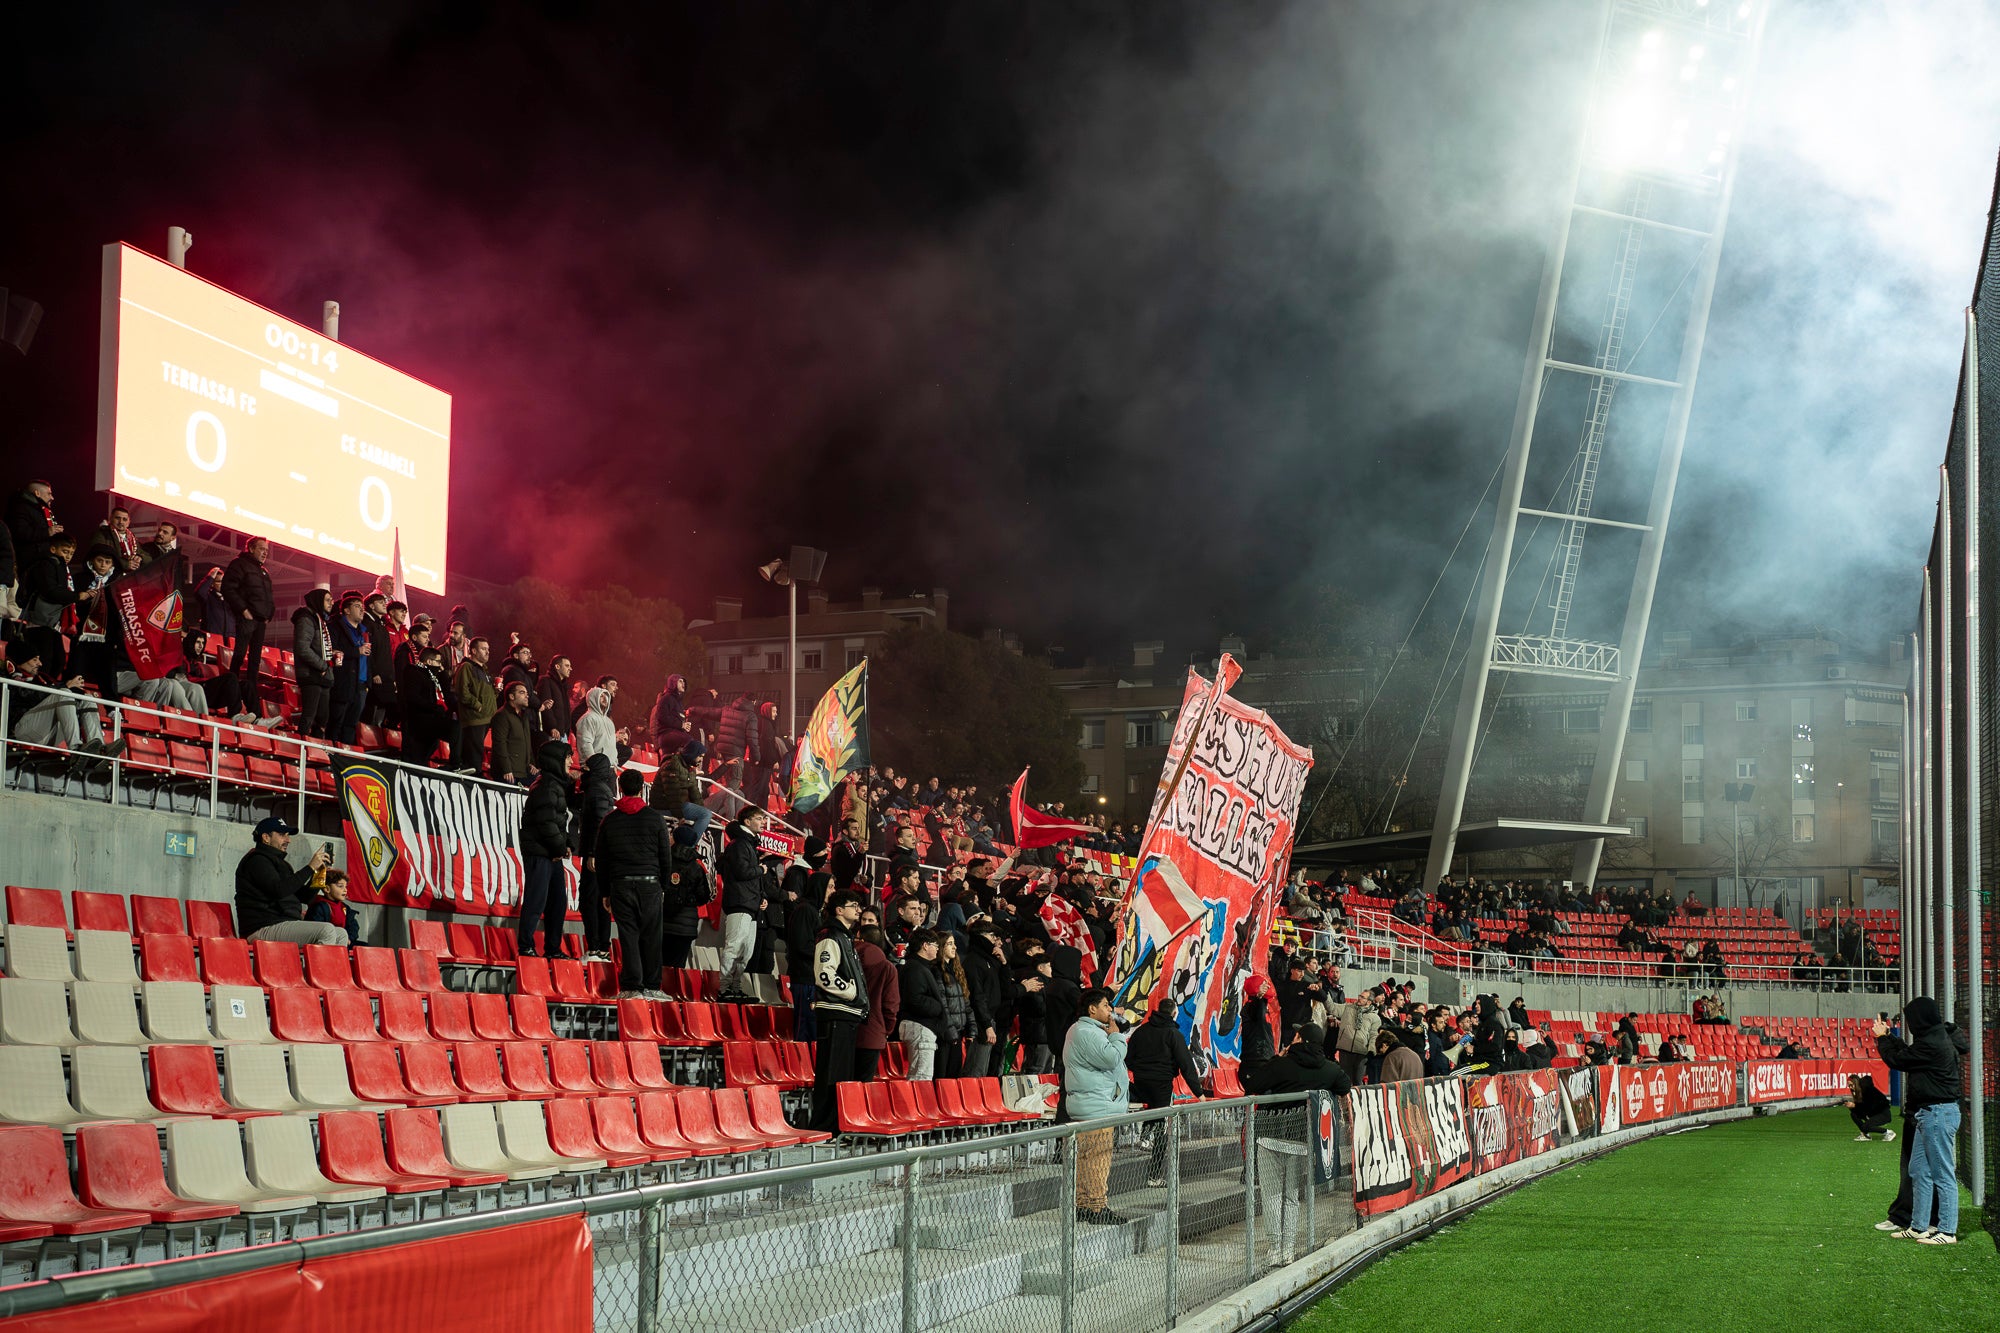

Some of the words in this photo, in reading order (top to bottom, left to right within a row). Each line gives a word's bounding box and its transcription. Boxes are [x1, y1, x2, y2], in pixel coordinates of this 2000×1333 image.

[265, 323, 339, 373] 00:14
[161, 361, 236, 408] TERRASSA
[240, 391, 257, 416] FC
[185, 410, 227, 473] 0
[358, 475, 393, 532] 0
[120, 588, 146, 646] TERRASSA
[138, 648, 152, 664] FC
[760, 834, 788, 854] rrassa
[1808, 1073, 1838, 1091] ESTRELLA
[1350, 1088, 1411, 1193] MALA
